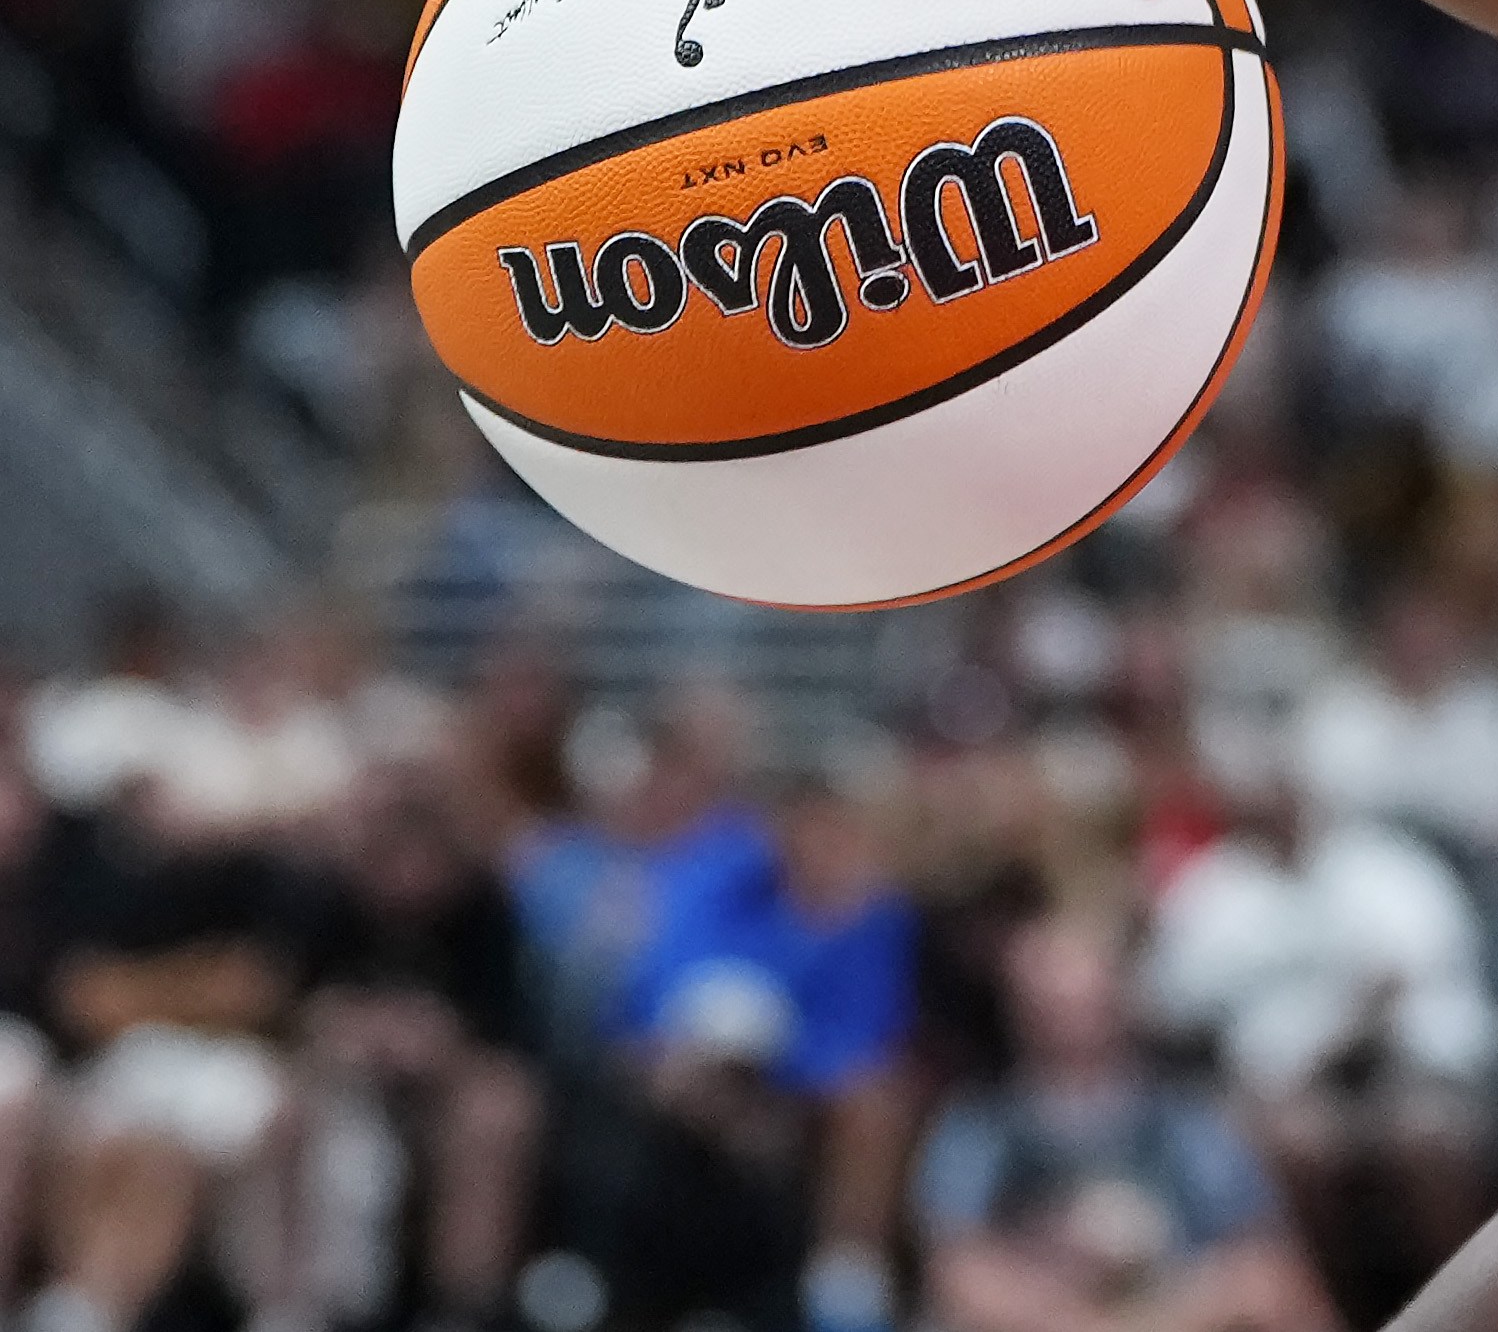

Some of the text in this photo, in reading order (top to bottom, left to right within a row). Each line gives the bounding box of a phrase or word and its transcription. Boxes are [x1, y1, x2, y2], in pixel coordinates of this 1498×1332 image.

[497, 115, 1099, 350] Wilson
[680, 134, 828, 189] EVO NXT
